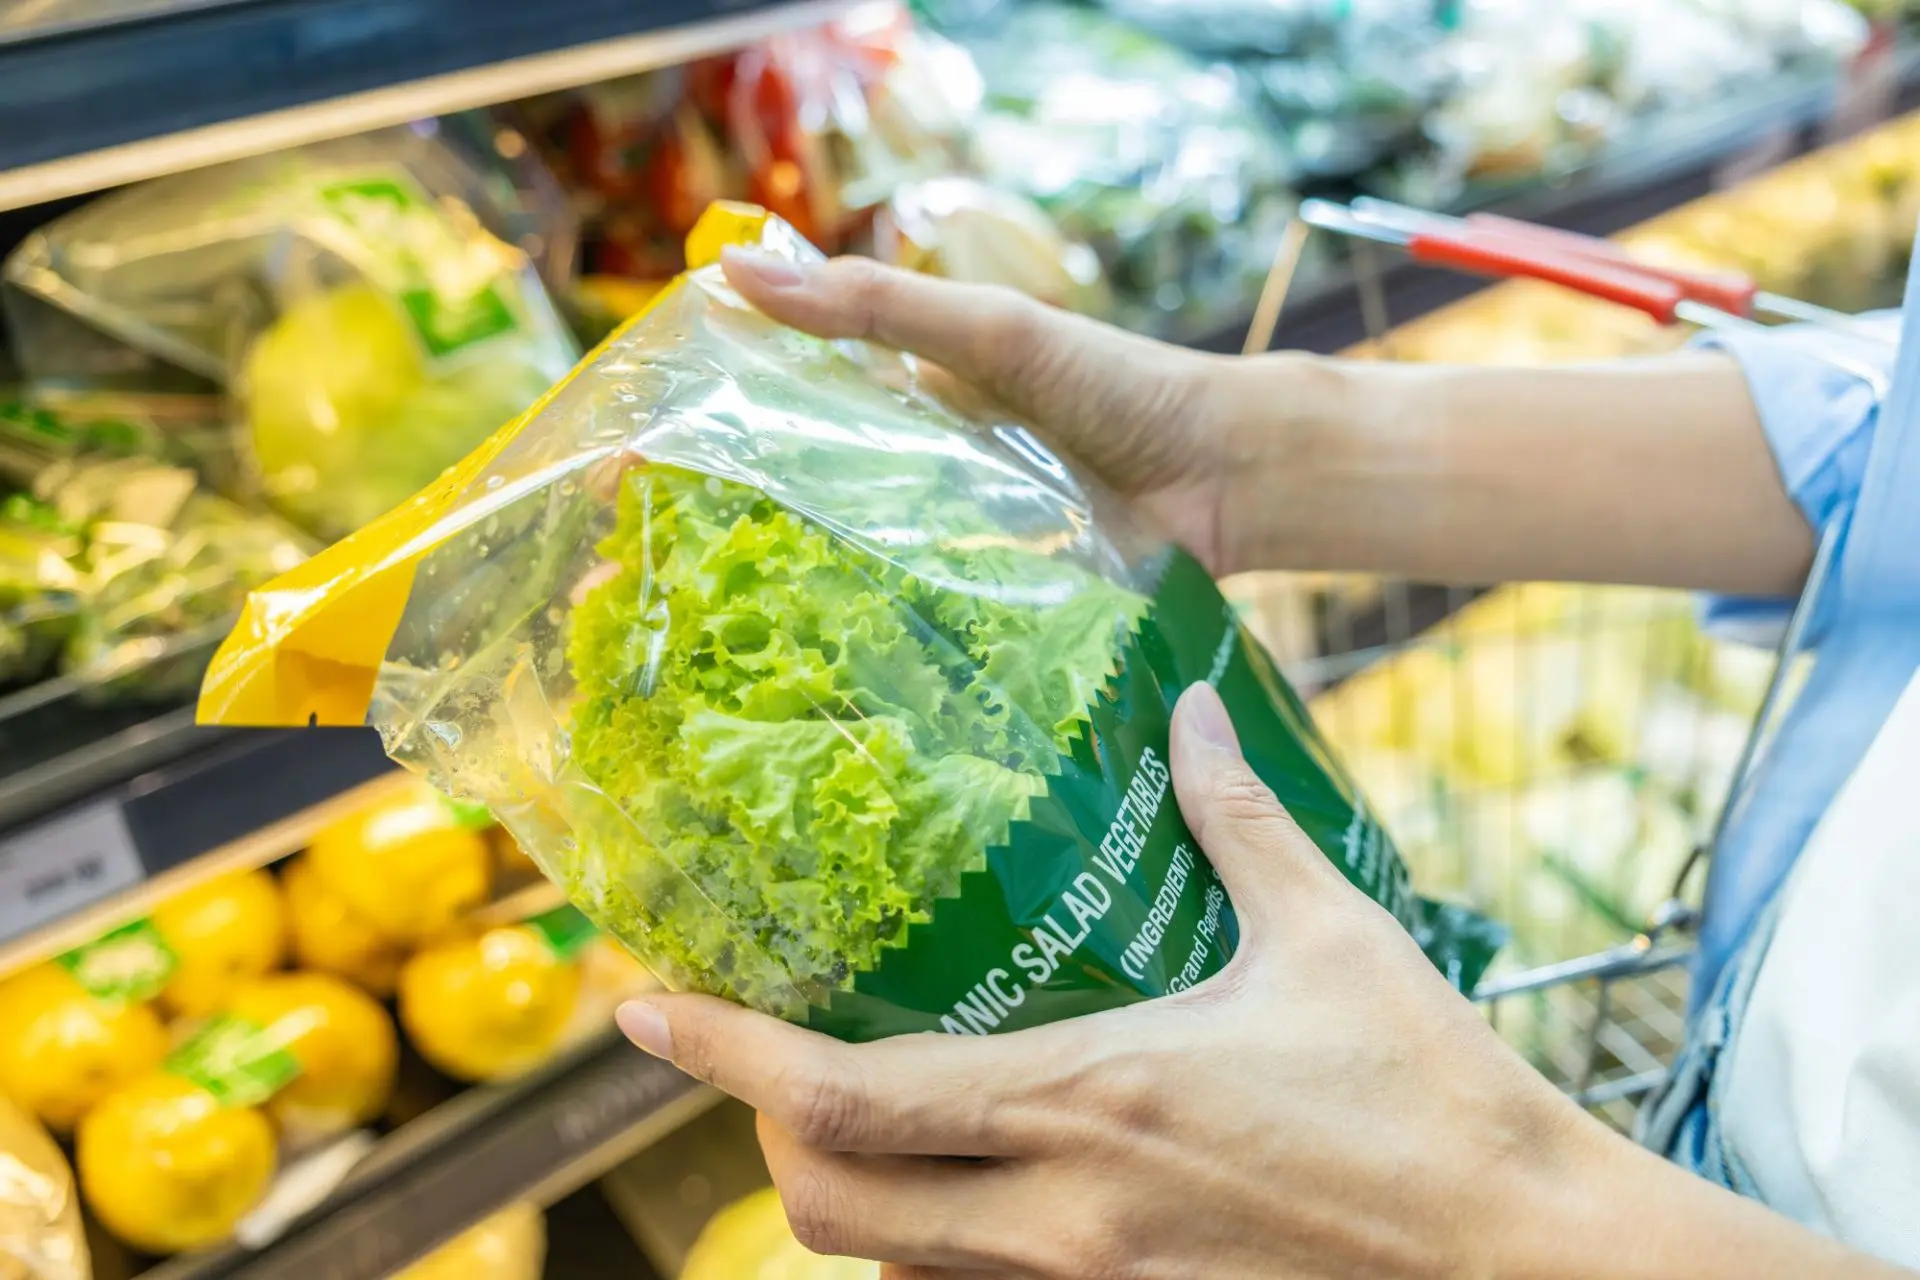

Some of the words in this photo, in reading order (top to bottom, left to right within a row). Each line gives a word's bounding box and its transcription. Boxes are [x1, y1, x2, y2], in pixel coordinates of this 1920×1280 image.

[922, 967, 1025, 1036] ANIC
[1012, 871, 1111, 983] SALAD
[1092, 746, 1170, 886] VEGETABLES
[1120, 843, 1195, 980] (INGREDIENT):
[1197, 884, 1224, 944] Rapids
